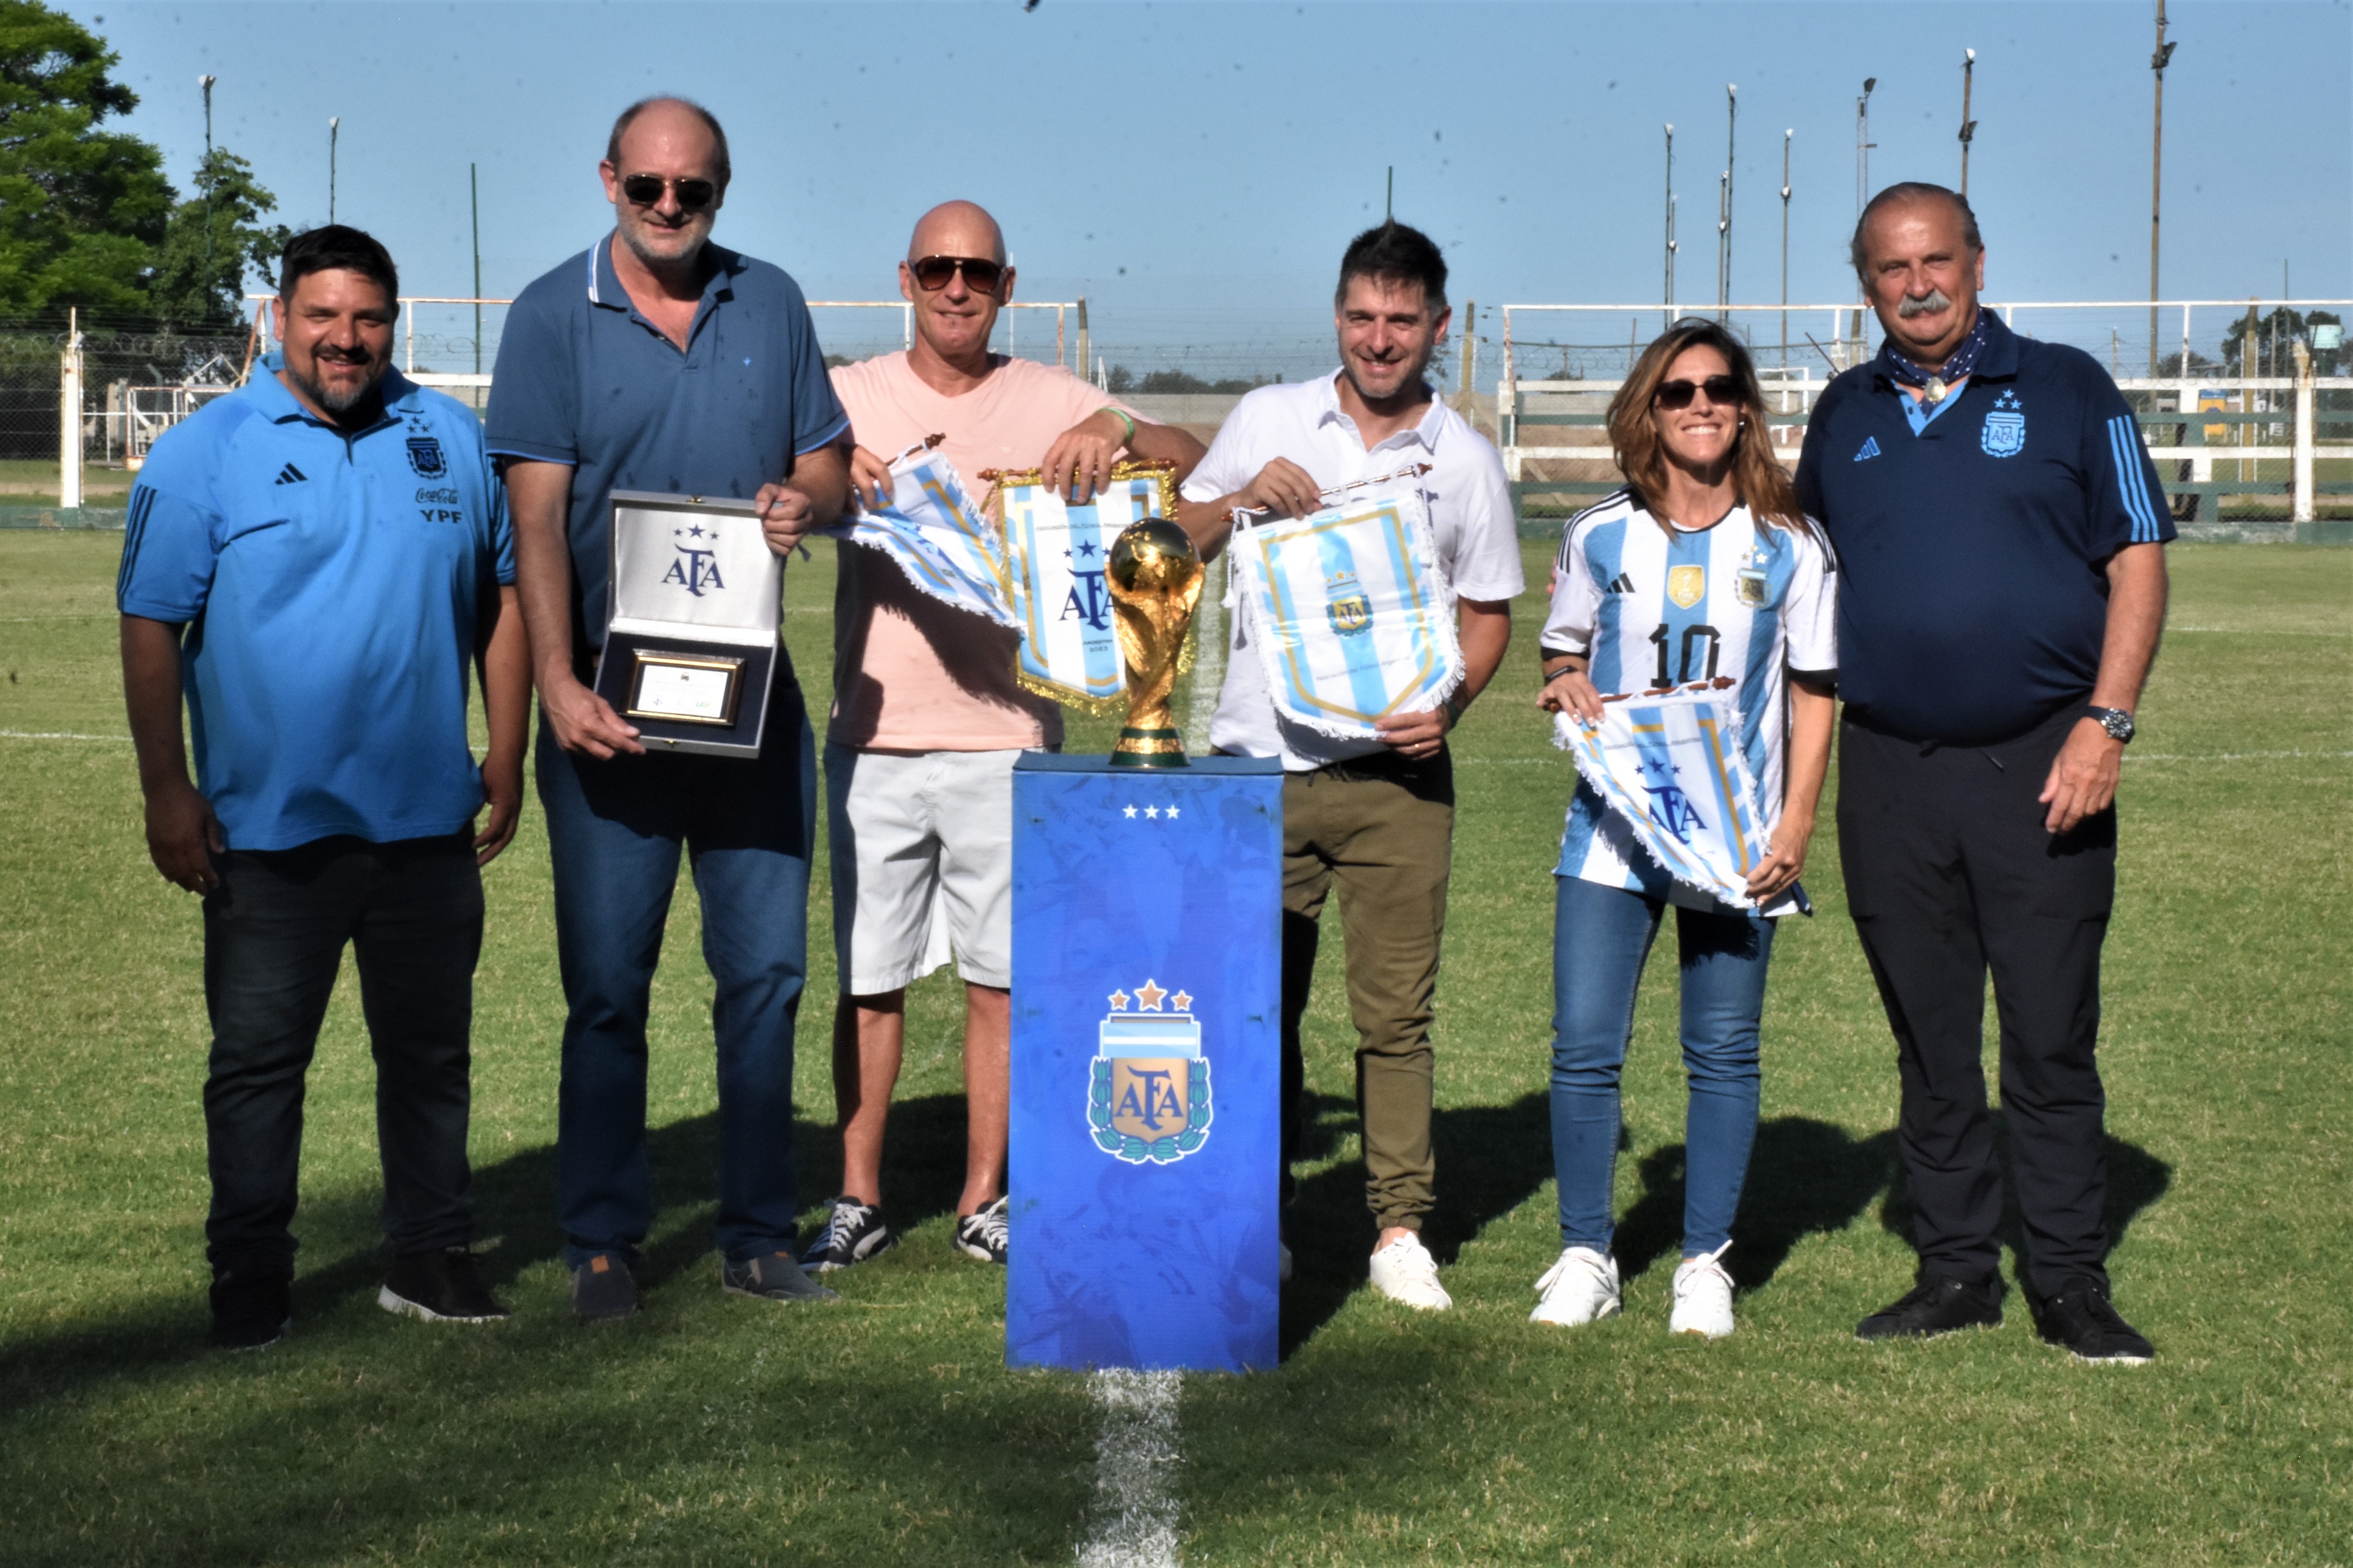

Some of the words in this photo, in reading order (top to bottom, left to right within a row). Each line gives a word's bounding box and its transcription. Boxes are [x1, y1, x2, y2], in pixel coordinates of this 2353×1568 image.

[1991, 424, 2014, 444] AFA
[419, 509, 462, 524] YPF
[661, 542, 726, 597] AFA
[1338, 601, 1363, 625] AFA
[1648, 623, 1721, 688] 10
[1113, 1064, 1184, 1131] AFA
